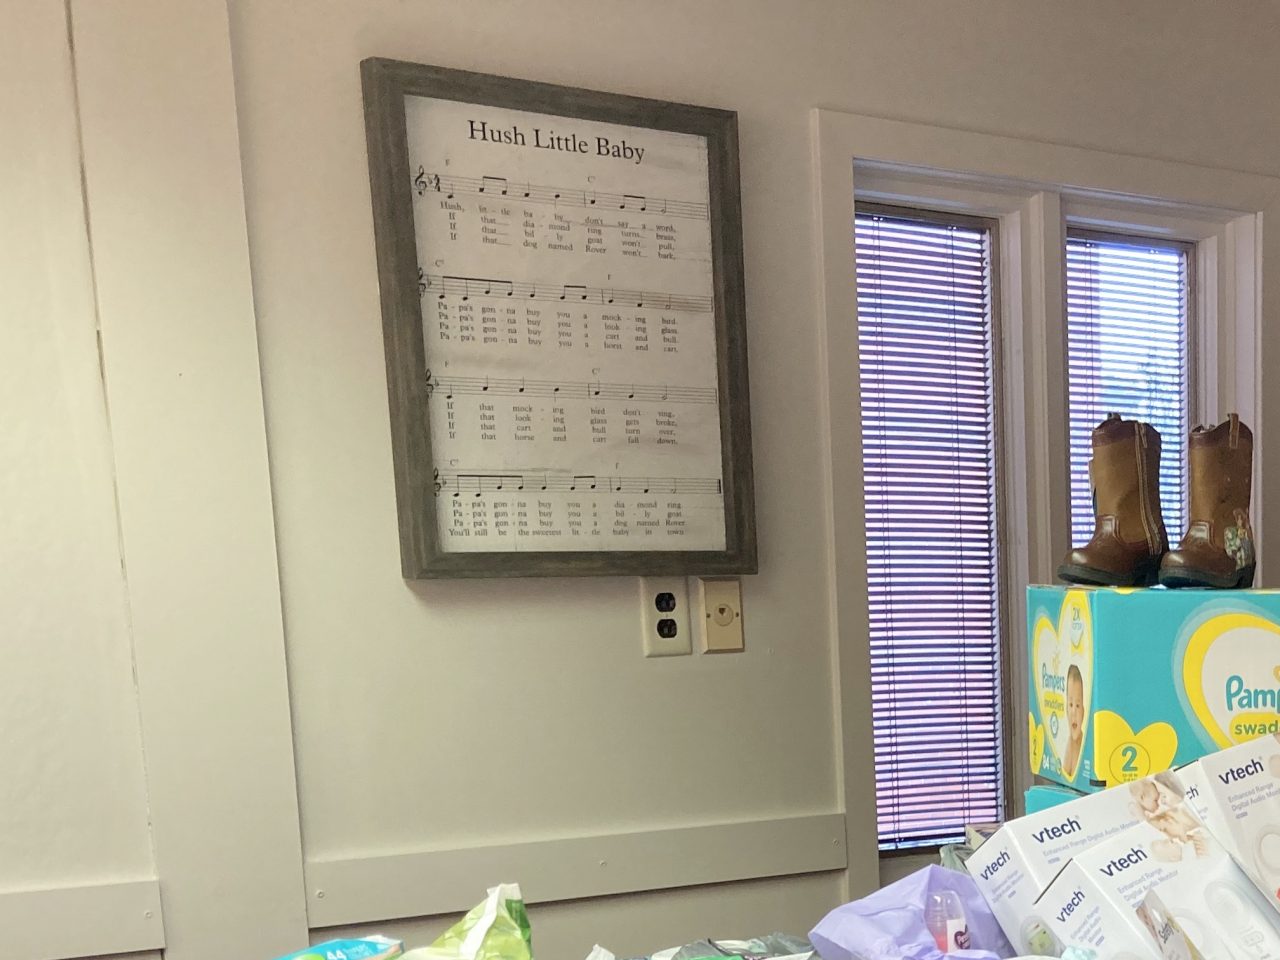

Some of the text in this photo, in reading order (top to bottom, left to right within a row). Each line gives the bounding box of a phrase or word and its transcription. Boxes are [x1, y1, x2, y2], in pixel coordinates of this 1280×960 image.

[467, 119, 645, 165] Hush Little Baby
[526, 308, 540, 318] buy
[526, 318, 540, 327] buy
[1042, 662, 1065, 693] Pampers
[1121, 745, 1138, 772] 2
[1218, 759, 1264, 785] vtech
[1032, 817, 1082, 843] vtech
[980, 849, 1011, 881] vtech
[1100, 847, 1148, 877] vtech
[1056, 889, 1085, 923] vtech
